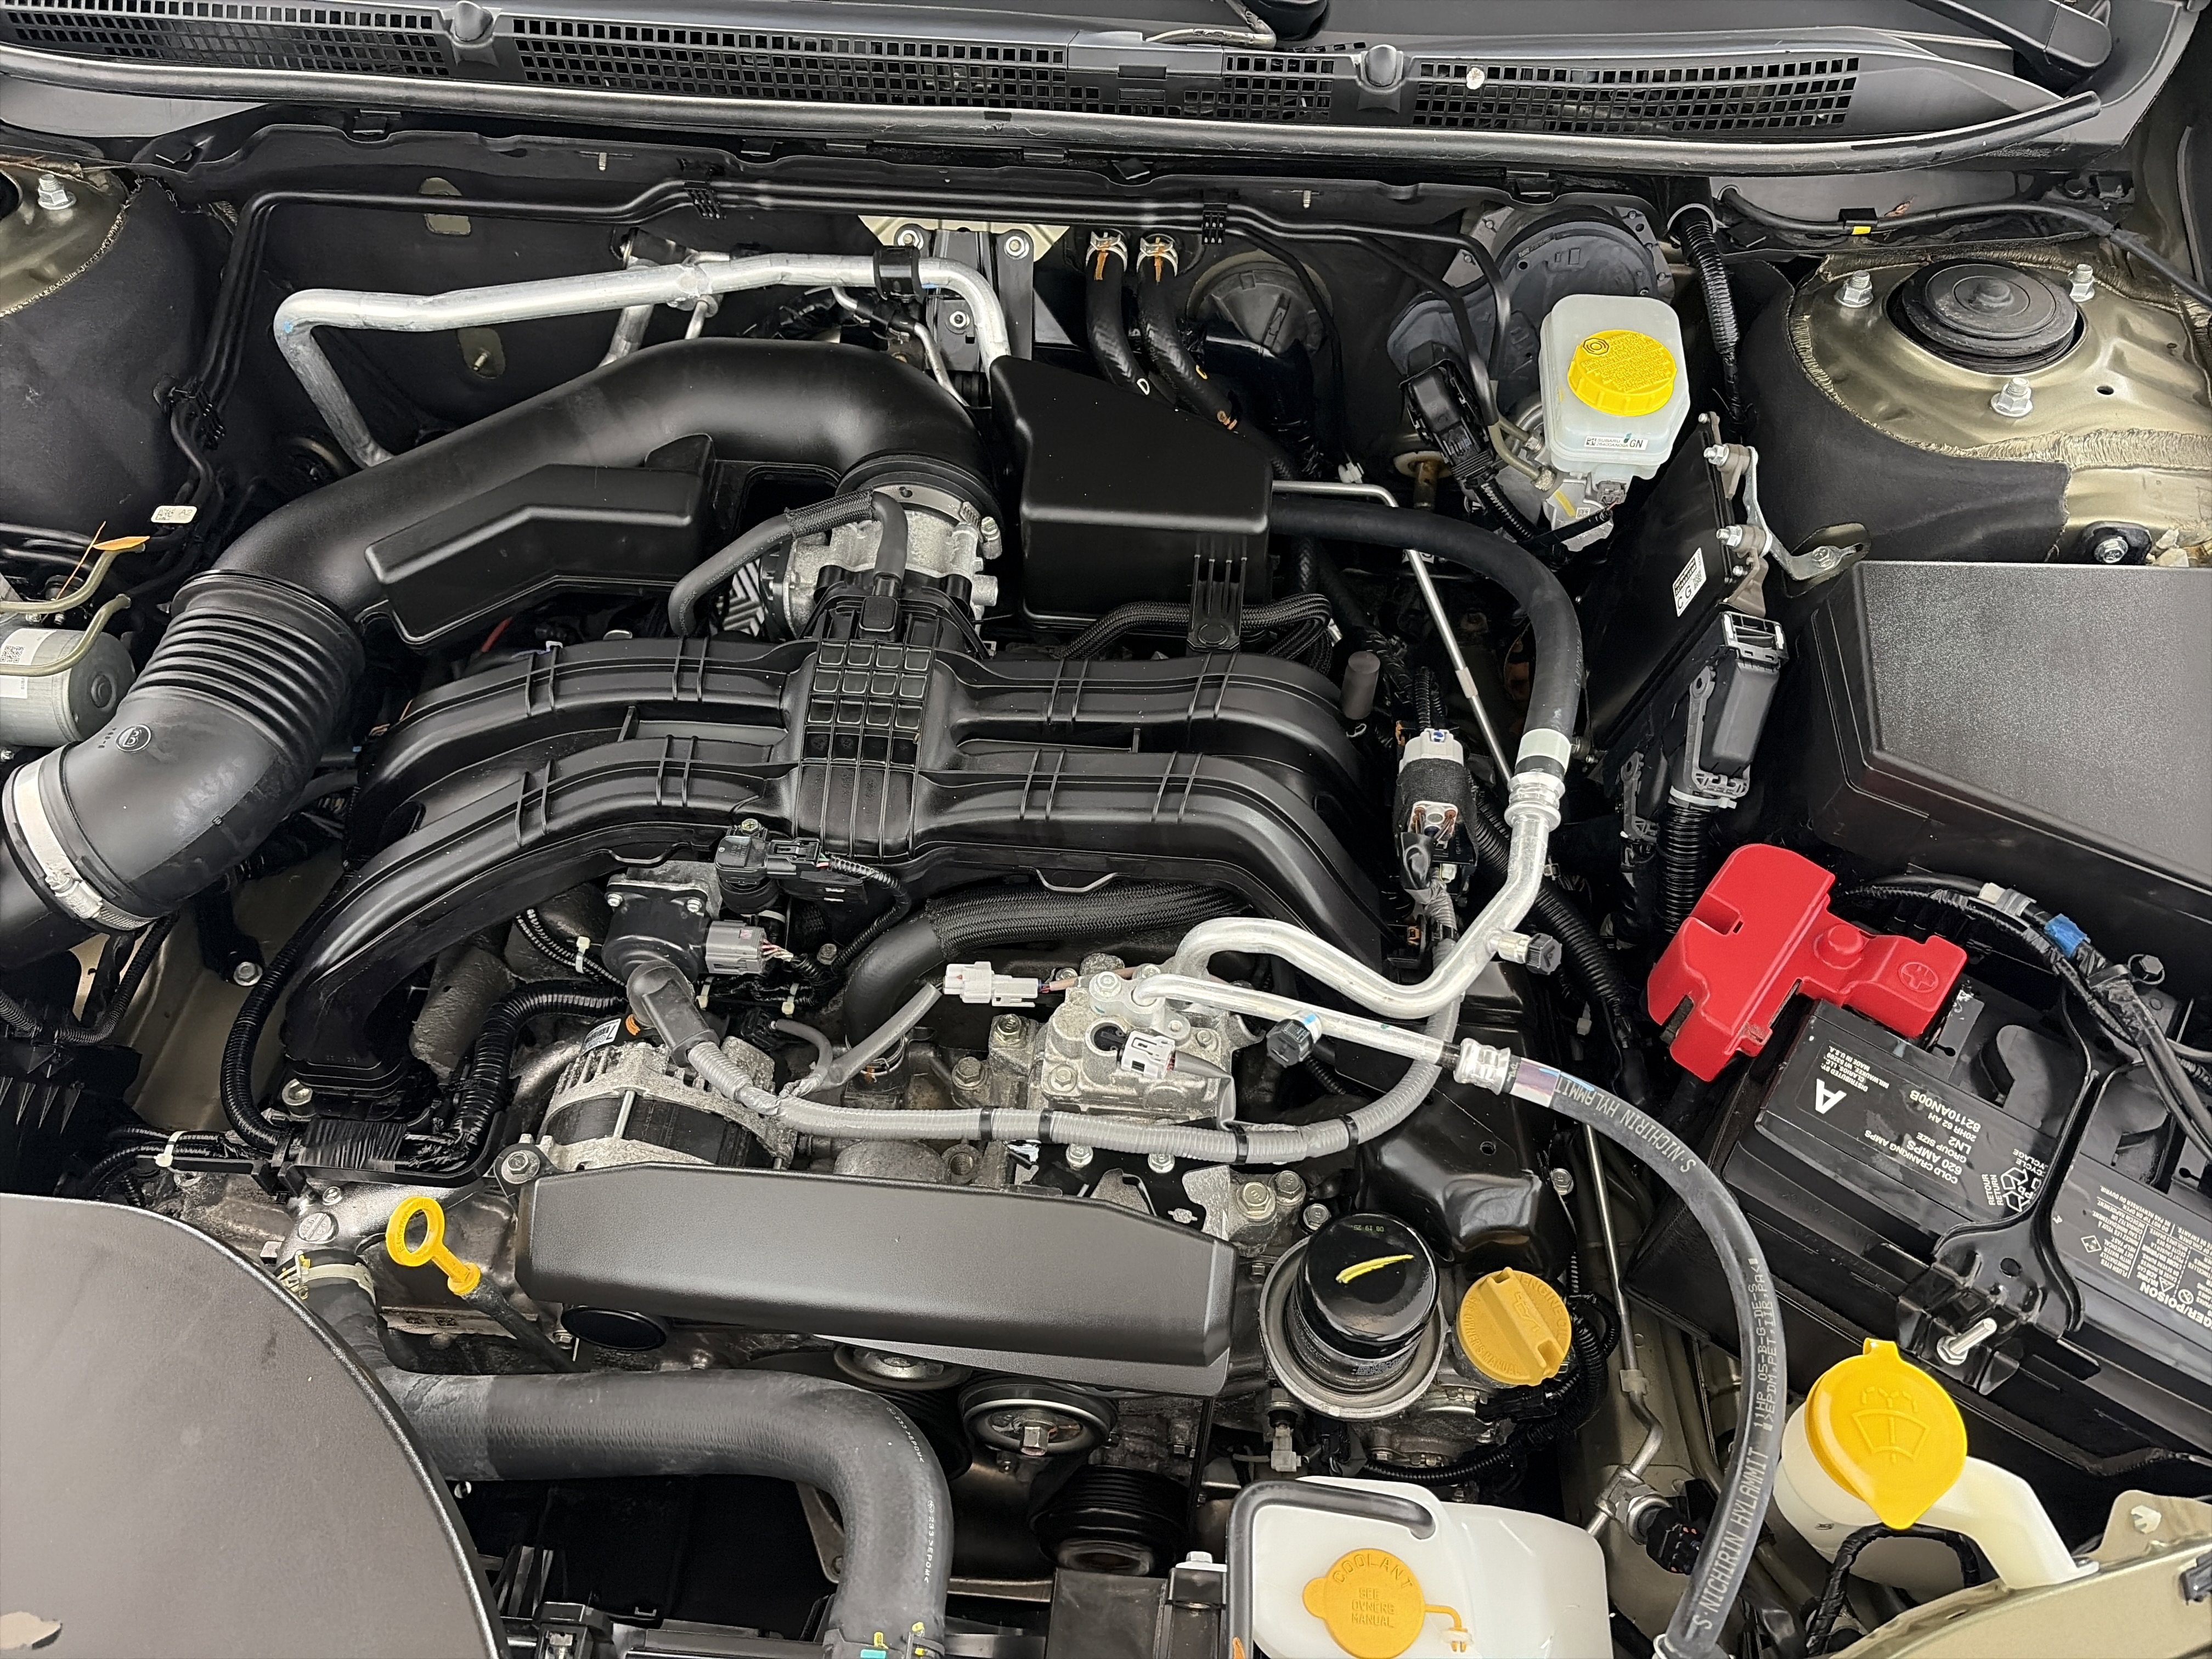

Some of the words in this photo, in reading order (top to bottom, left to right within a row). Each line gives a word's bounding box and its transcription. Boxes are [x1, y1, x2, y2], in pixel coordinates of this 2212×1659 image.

[1629, 439, 1644, 448] GN
[1685, 585, 1691, 599] G
[1827, 1053, 1844, 1065] 53209
[1829, 1046, 1846, 1058] U.S.A.
[1821, 1063, 1830, 1071] BY:
[1852, 1059, 1870, 1071] MADE
[1831, 1069, 1868, 1092] DISTRIBUTED
[1555, 1076, 1620, 1118] HYLAMMIT
[1815, 1079, 1847, 1114] A
[1910, 1091, 1980, 1132] 82110AN00B
[1928, 1113, 1942, 1123] AH
[1942, 1120, 1953, 1129] 62
[1865, 1130, 1889, 1146] AMPS
[1916, 1132, 1936, 1147] SIZE
[1954, 1126, 1976, 1142] 20HR
[1907, 1140, 1941, 1163] AMPS
[1949, 1136, 1971, 1154] LN2
[1889, 1143, 1933, 1170] CRANKING
[1936, 1144, 1966, 1163] GROUP
[1942, 1159, 1962, 1175] 620
[1934, 1167, 1957, 1183] COLD
[1982, 1174, 1995, 1205] RETOUR
[1990, 1175, 2004, 1206] RETURN
[2018, 1186, 2034, 1199] Pb
[2101, 1186, 2119, 1199] OUVRIR.
[2097, 1198, 2125, 1218] RAPIDEMENT.
[2123, 1204, 2135, 1214] OPEN.
[2127, 1200, 2154, 1218] RENVERSER
[2102, 1223, 2113, 1233] YEUX
[2118, 1218, 2142, 1234] CONSULTEZ
[2151, 1220, 2161, 1228] NOT
[2111, 1236, 2124, 1246] FAST.
[2114, 1229, 2123, 1238] LES
[2178, 1227, 2199, 1242] ENFANTS.
[2104, 1239, 2124, 1254] MEDICAL
[2124, 1244, 2136, 1253] HELP
[2177, 1234, 2204, 1250] CHILDREN.
[2101, 1246, 2119, 1259] WATER.
[2124, 1251, 2134, 1259] GET
[2157, 1246, 2172, 1257] CAUSER
[2173, 1255, 2183, 1263] PEUT
[2100, 1252, 2129, 1271] IMMEDIATELY
[2101, 1259, 2112, 1268] EYES
[2120, 1255, 2131, 1265] WITH
[2157, 1261, 2172, 1273] SEVERE
[2112, 1266, 2128, 1277] FLUSH
[2163, 1272, 2177, 1283] CAUSE
[2137, 1272, 2158, 1287] SULFURIC
[1520, 1273, 1562, 1317] ENGINE
[1556, 1319, 1567, 1344] OIL
[2140, 1282, 2212, 1328] GER/POISON
[1482, 1352, 1519, 1376] MANUAL
[1729, 1446, 1769, 1528] HYLAMMIT
[1333, 1554, 1414, 1589] COOLANT
[1359, 1587, 1381, 1600] SEE
[1351, 1612, 1396, 1628] MANUAL
